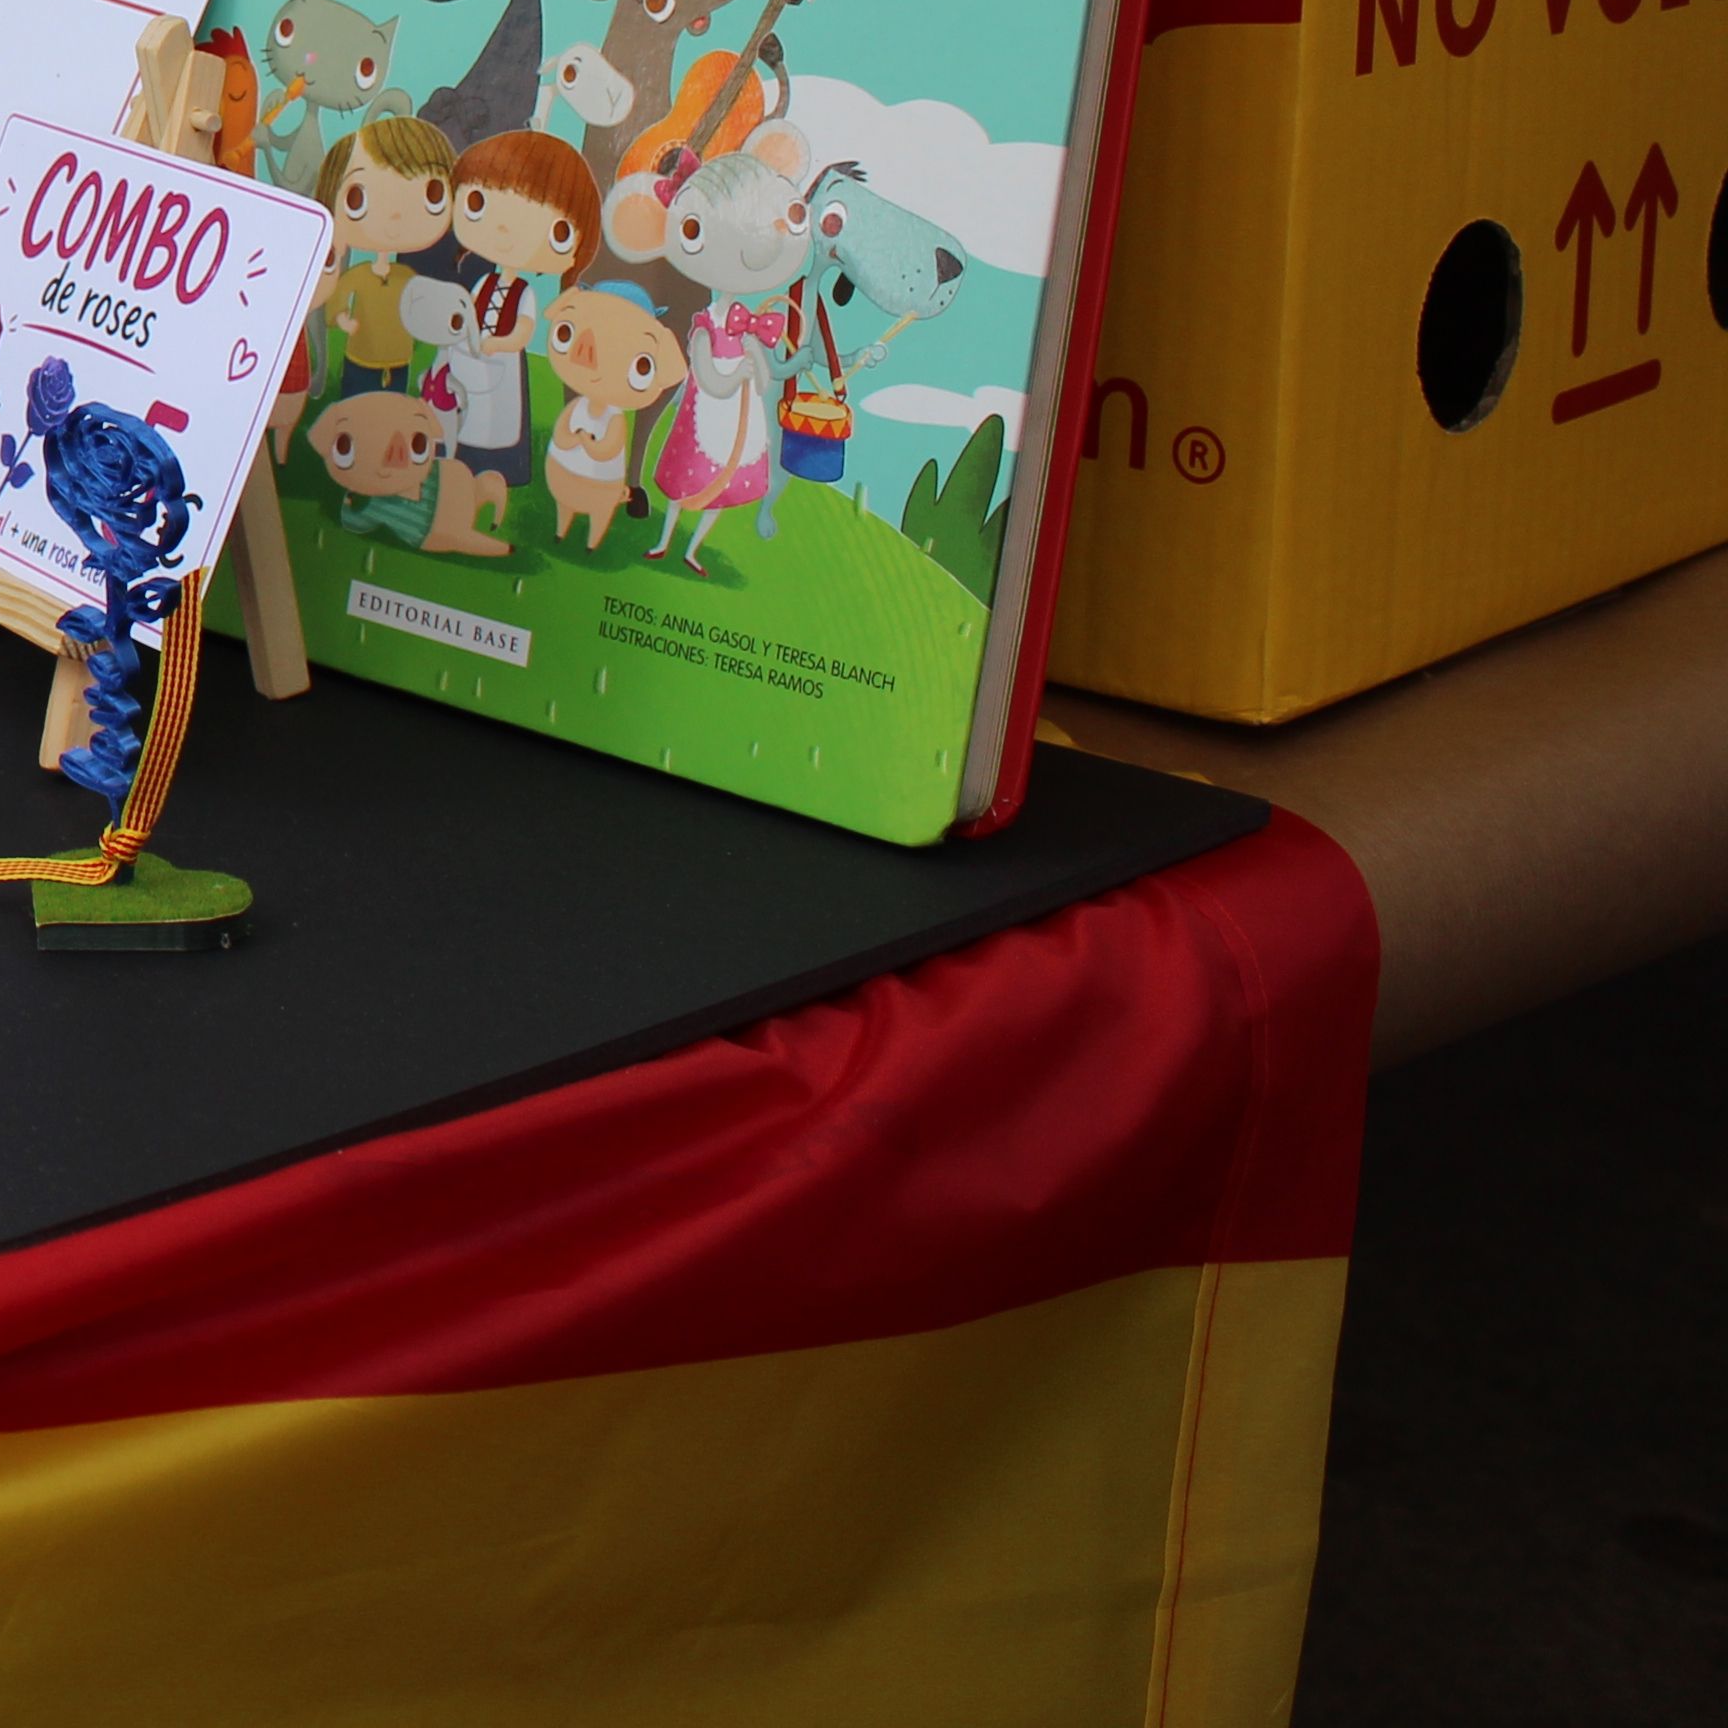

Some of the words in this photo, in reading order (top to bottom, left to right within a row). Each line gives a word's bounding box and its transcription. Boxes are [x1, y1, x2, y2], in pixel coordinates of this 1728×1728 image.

[22, 152, 229, 305] COMBO
[41, 261, 76, 314] de
[78, 288, 157, 347] roses
[21, 530, 48, 555] una
[48, 543, 80, 572] rosa
[79, 560, 106, 587] eter
[359, 592, 465, 637] EDITORIAL
[473, 624, 520, 654] BASE
[598, 620, 709, 666] ILUSTRACIONES:
[714, 653, 764, 682] TERESA
[768, 669, 824, 699] RAMOS
[603, 596, 657, 626] TEXTOS:
[661, 613, 704, 639] ANNA
[708, 626, 757, 655] GASOL
[762, 640, 772, 657] Y
[775, 643, 826, 674] TERESA
[831, 660, 895, 692] BLANCH
